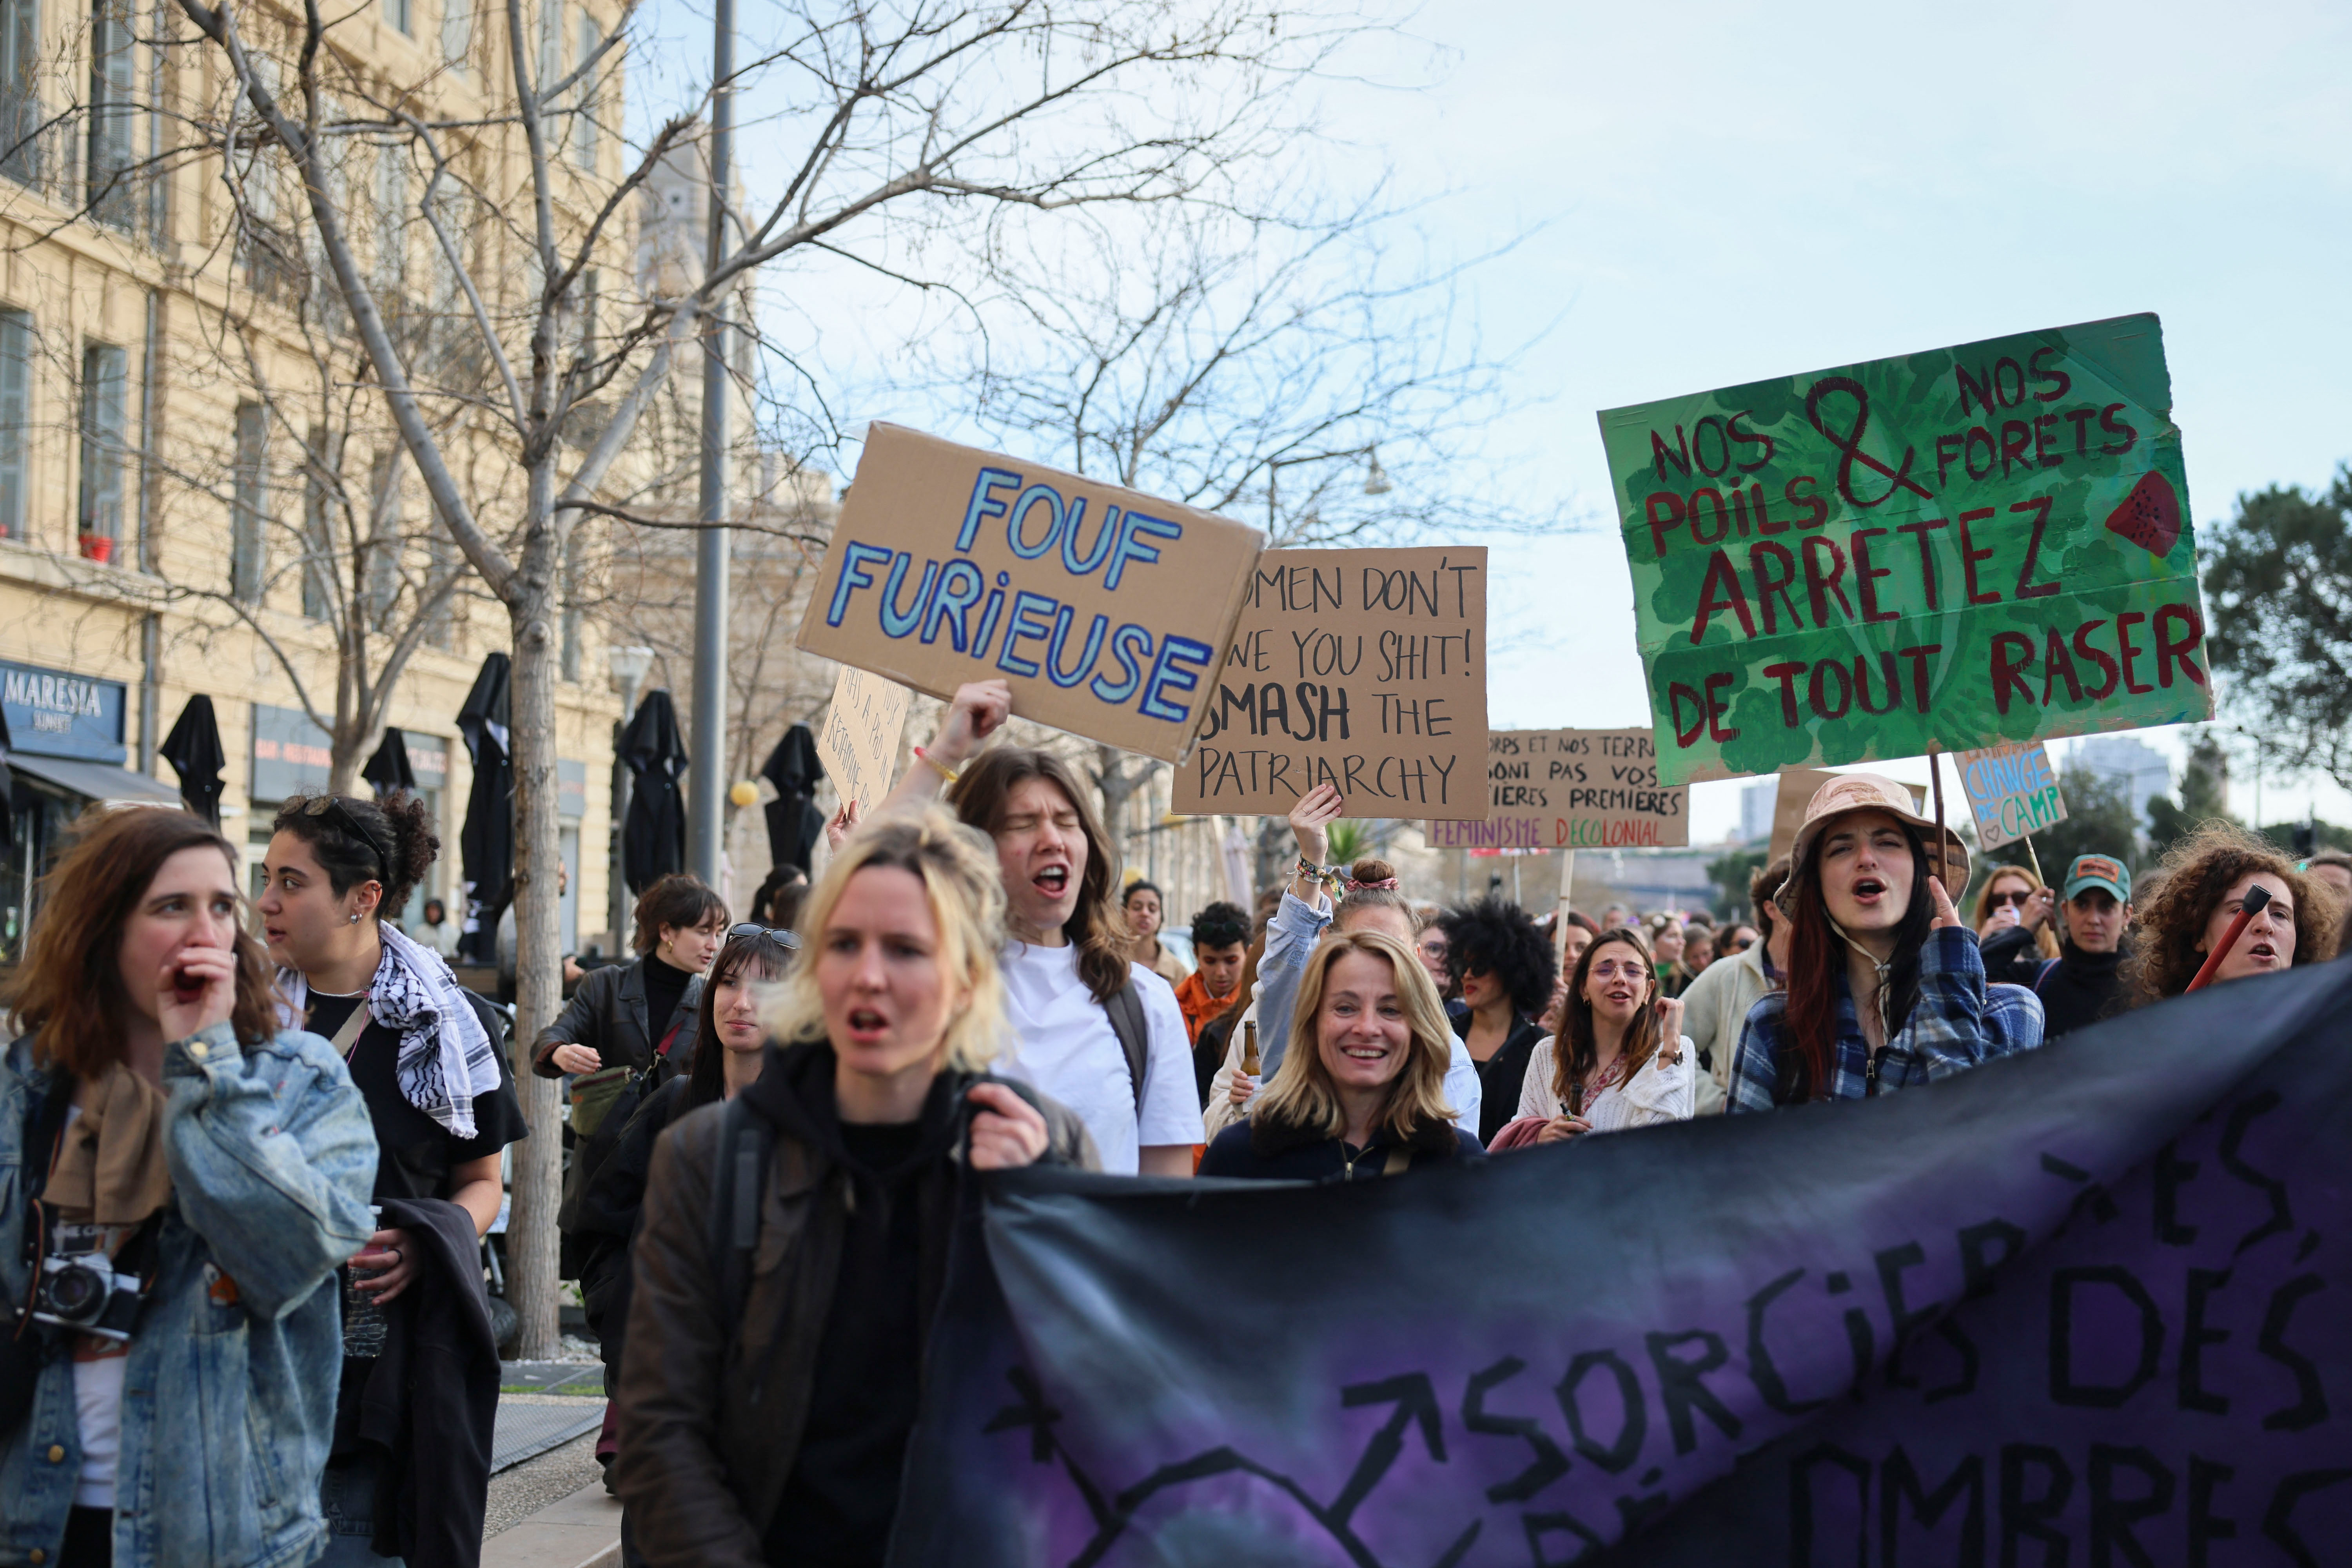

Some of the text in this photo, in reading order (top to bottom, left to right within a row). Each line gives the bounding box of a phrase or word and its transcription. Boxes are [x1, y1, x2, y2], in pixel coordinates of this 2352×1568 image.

[1651, 347, 2072, 506] NOS & NOS
[1936, 403, 2138, 488] FORETS
[955, 467, 1182, 591] FOUF
[1244, 557, 1477, 618] MEN DON'T
[1690, 495, 2062, 645] ARRETEZ
[1292, 628, 1362, 678] YOU
[1376, 629, 1471, 682] SHIT!
[1668, 603, 2207, 748] DE TOUT RASER
[4, 669, 102, 717] MARESIA
[1372, 693, 1452, 736] THE
[828, 704, 862, 799] KETAMINE
[862, 694, 871, 727] A
[879, 752, 888, 788] IN
[1529, 736, 1548, 752] ET
[1558, 737, 1590, 755] NOS
[1598, 736, 1655, 759] TERR
[1200, 747, 1456, 804] PATRIARCHY
[1549, 761, 1588, 782] PAS
[1611, 764, 1657, 788] VOS
[1966, 748, 2052, 800] CHANGE
[1433, 817, 1541, 848] FEMINISME
[1976, 786, 2059, 837] DE CAMP
[2049, 1264, 2330, 1432] DES
